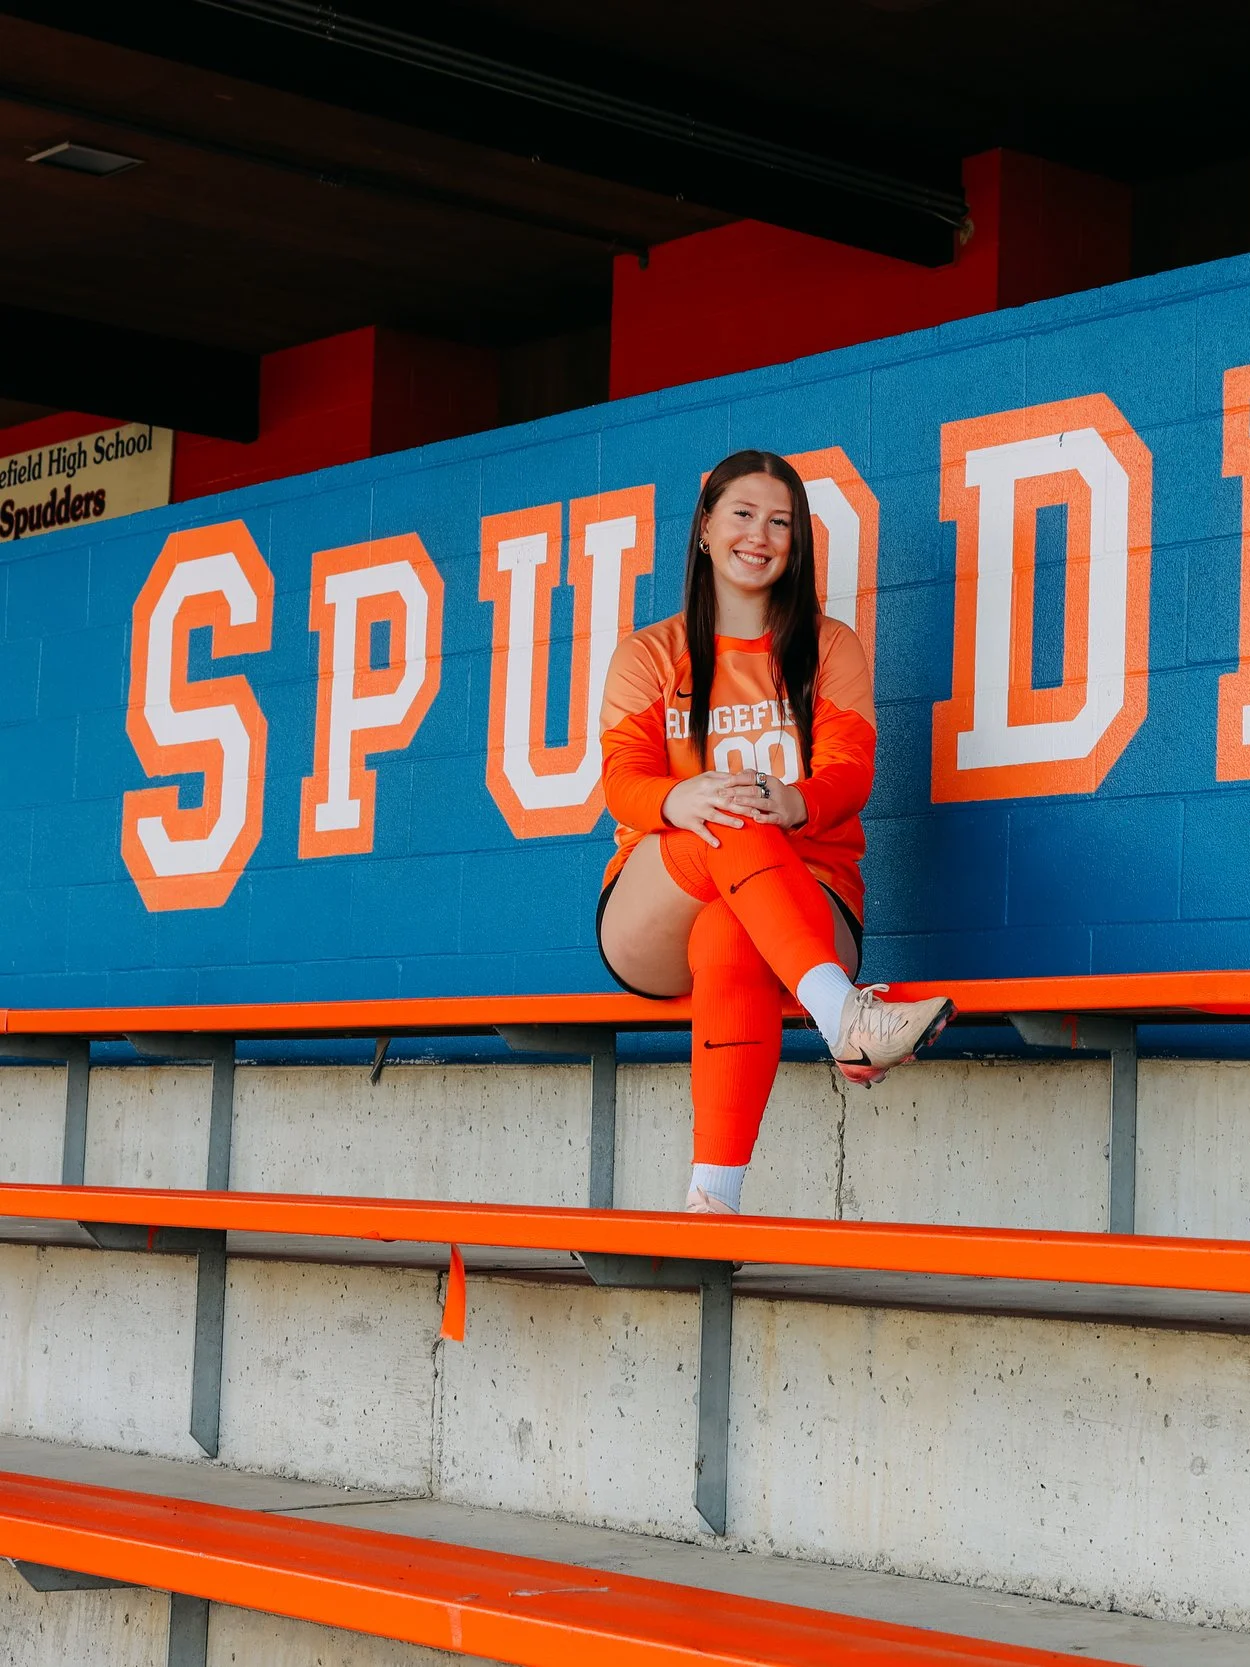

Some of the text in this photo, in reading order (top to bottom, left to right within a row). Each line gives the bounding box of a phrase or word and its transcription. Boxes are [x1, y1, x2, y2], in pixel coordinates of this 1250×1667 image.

[48, 441, 87, 478] High
[93, 425, 153, 465] School
[0, 484, 106, 540] Spudders
[714, 730, 799, 786] 00
